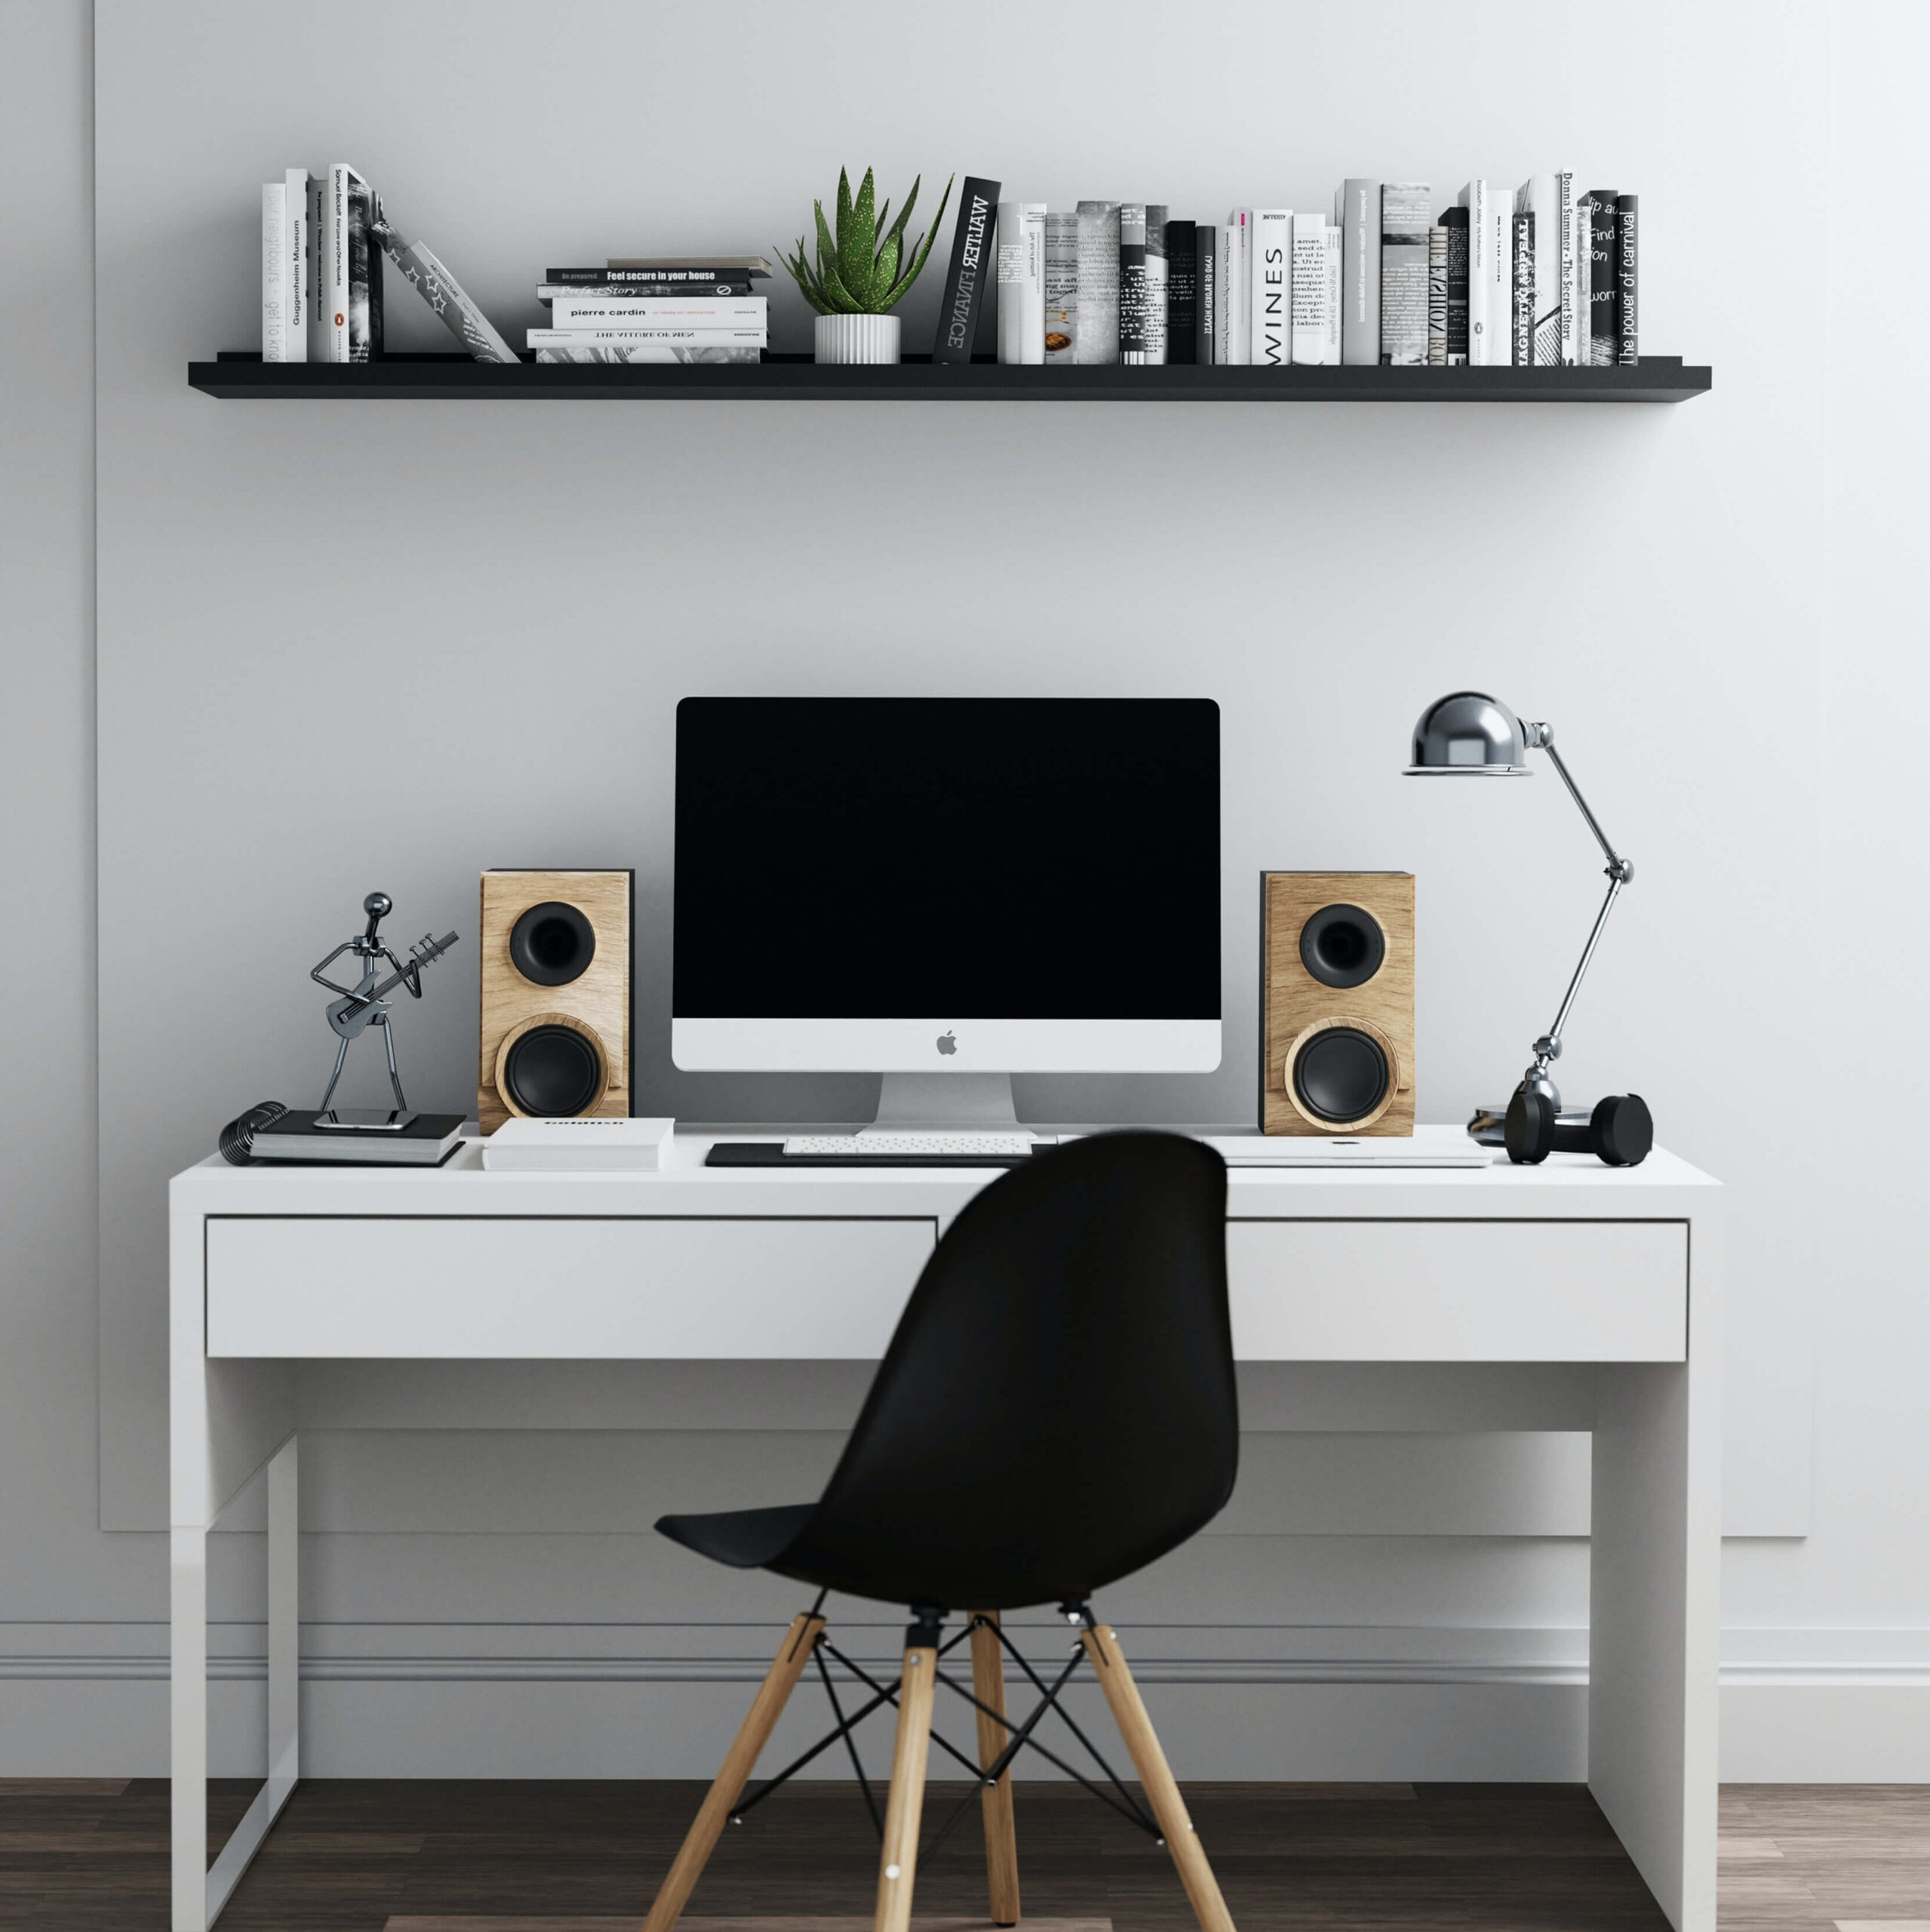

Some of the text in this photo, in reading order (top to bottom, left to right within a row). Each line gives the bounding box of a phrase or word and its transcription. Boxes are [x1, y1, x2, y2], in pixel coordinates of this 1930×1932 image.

[265, 219, 284, 283] neighbours
[1562, 172, 1573, 340] Donna Summer The Secret Story
[293, 264, 301, 326] Guggenheim
[429, 264, 459, 298] ARCHITECTURE
[604, 287, 638, 297] Story
[607, 272, 625, 281] Feel
[626, 272, 656, 281] secure
[658, 272, 666, 280] in
[668, 272, 687, 281] your
[688, 272, 715, 280] house
[1618, 211, 1639, 366] The power of carnival
[265, 302, 281, 319] get
[269, 325, 283, 336] to
[1265, 248, 1283, 365] WINES
